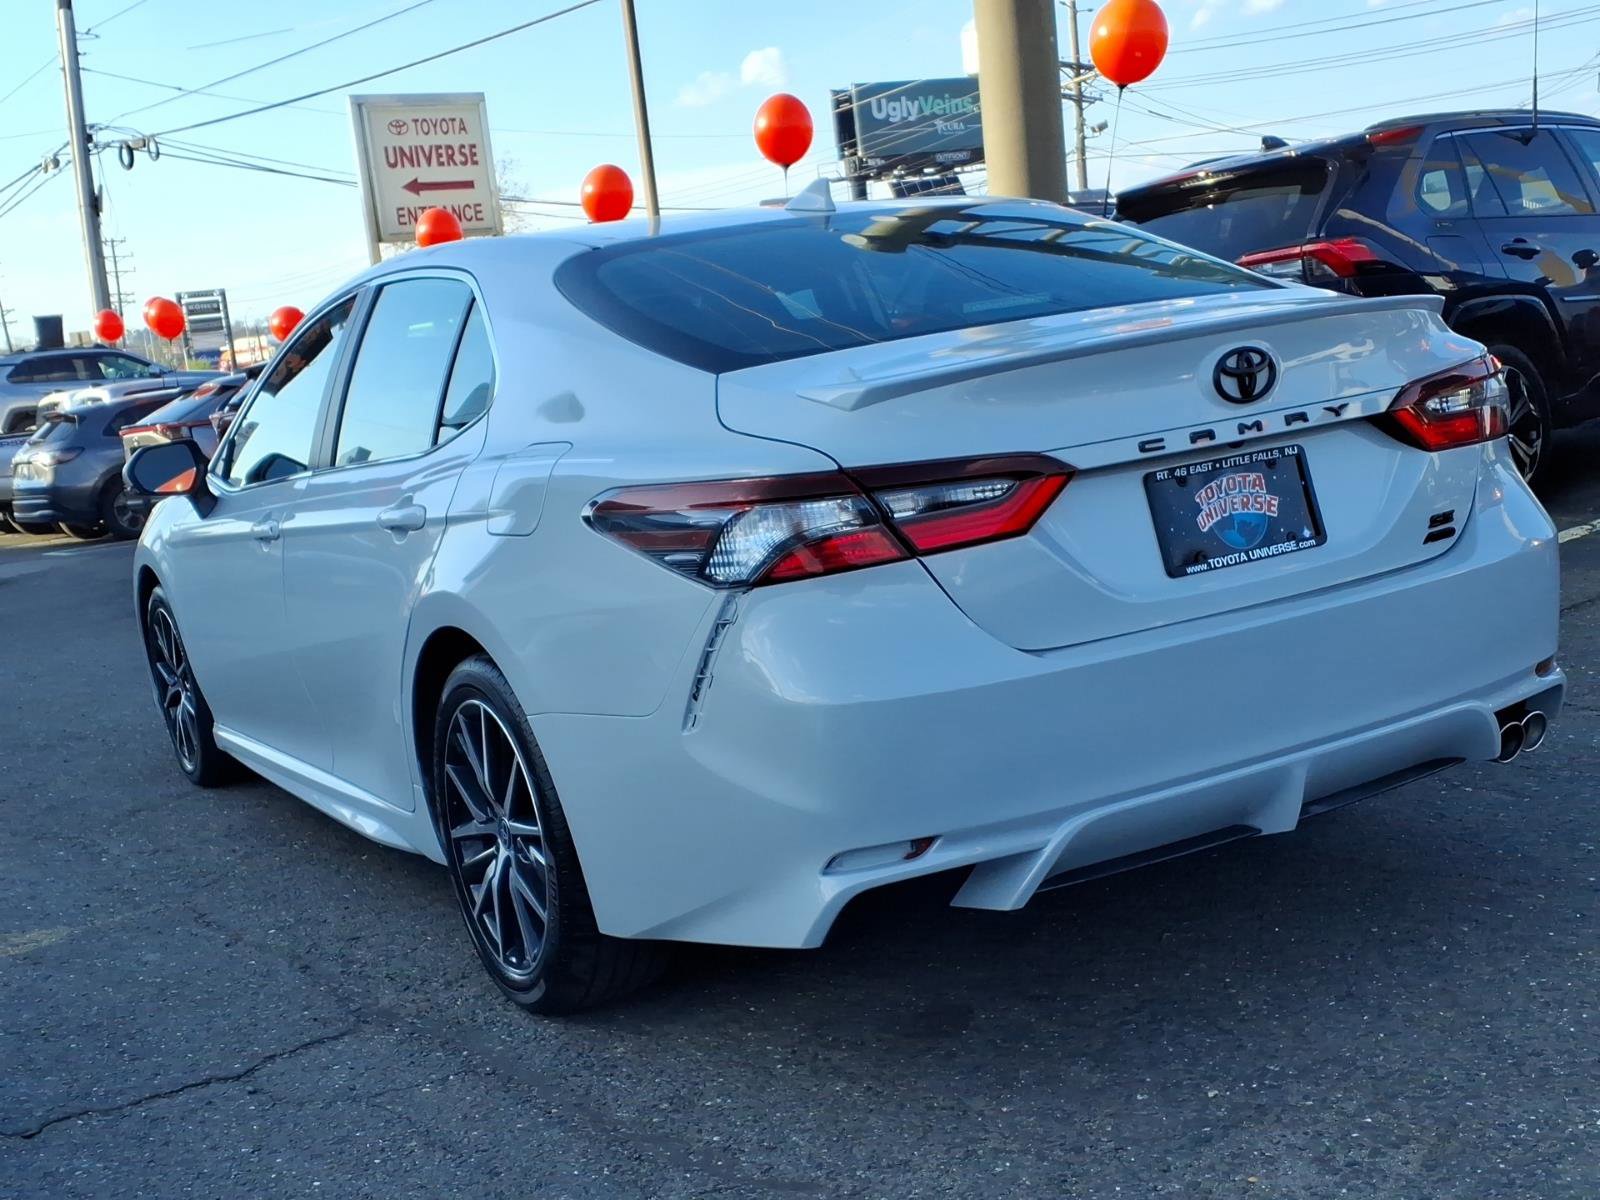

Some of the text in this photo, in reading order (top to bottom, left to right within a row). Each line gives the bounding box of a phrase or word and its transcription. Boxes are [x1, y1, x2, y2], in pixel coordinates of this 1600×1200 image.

[412, 118, 467, 135] TOYOTA
[384, 144, 479, 169] UNIVERSE
[1138, 402, 1350, 453] CAMRY
[1174, 467, 1188, 478] 46
[1189, 463, 1214, 475] EAST
[1221, 455, 1251, 469] LITTLE
[1252, 449, 1283, 463] FALLS,
[1284, 446, 1299, 457] NJ
[1194, 472, 1267, 506] TOYOTA
[1196, 493, 1280, 532] UNIVERSE
